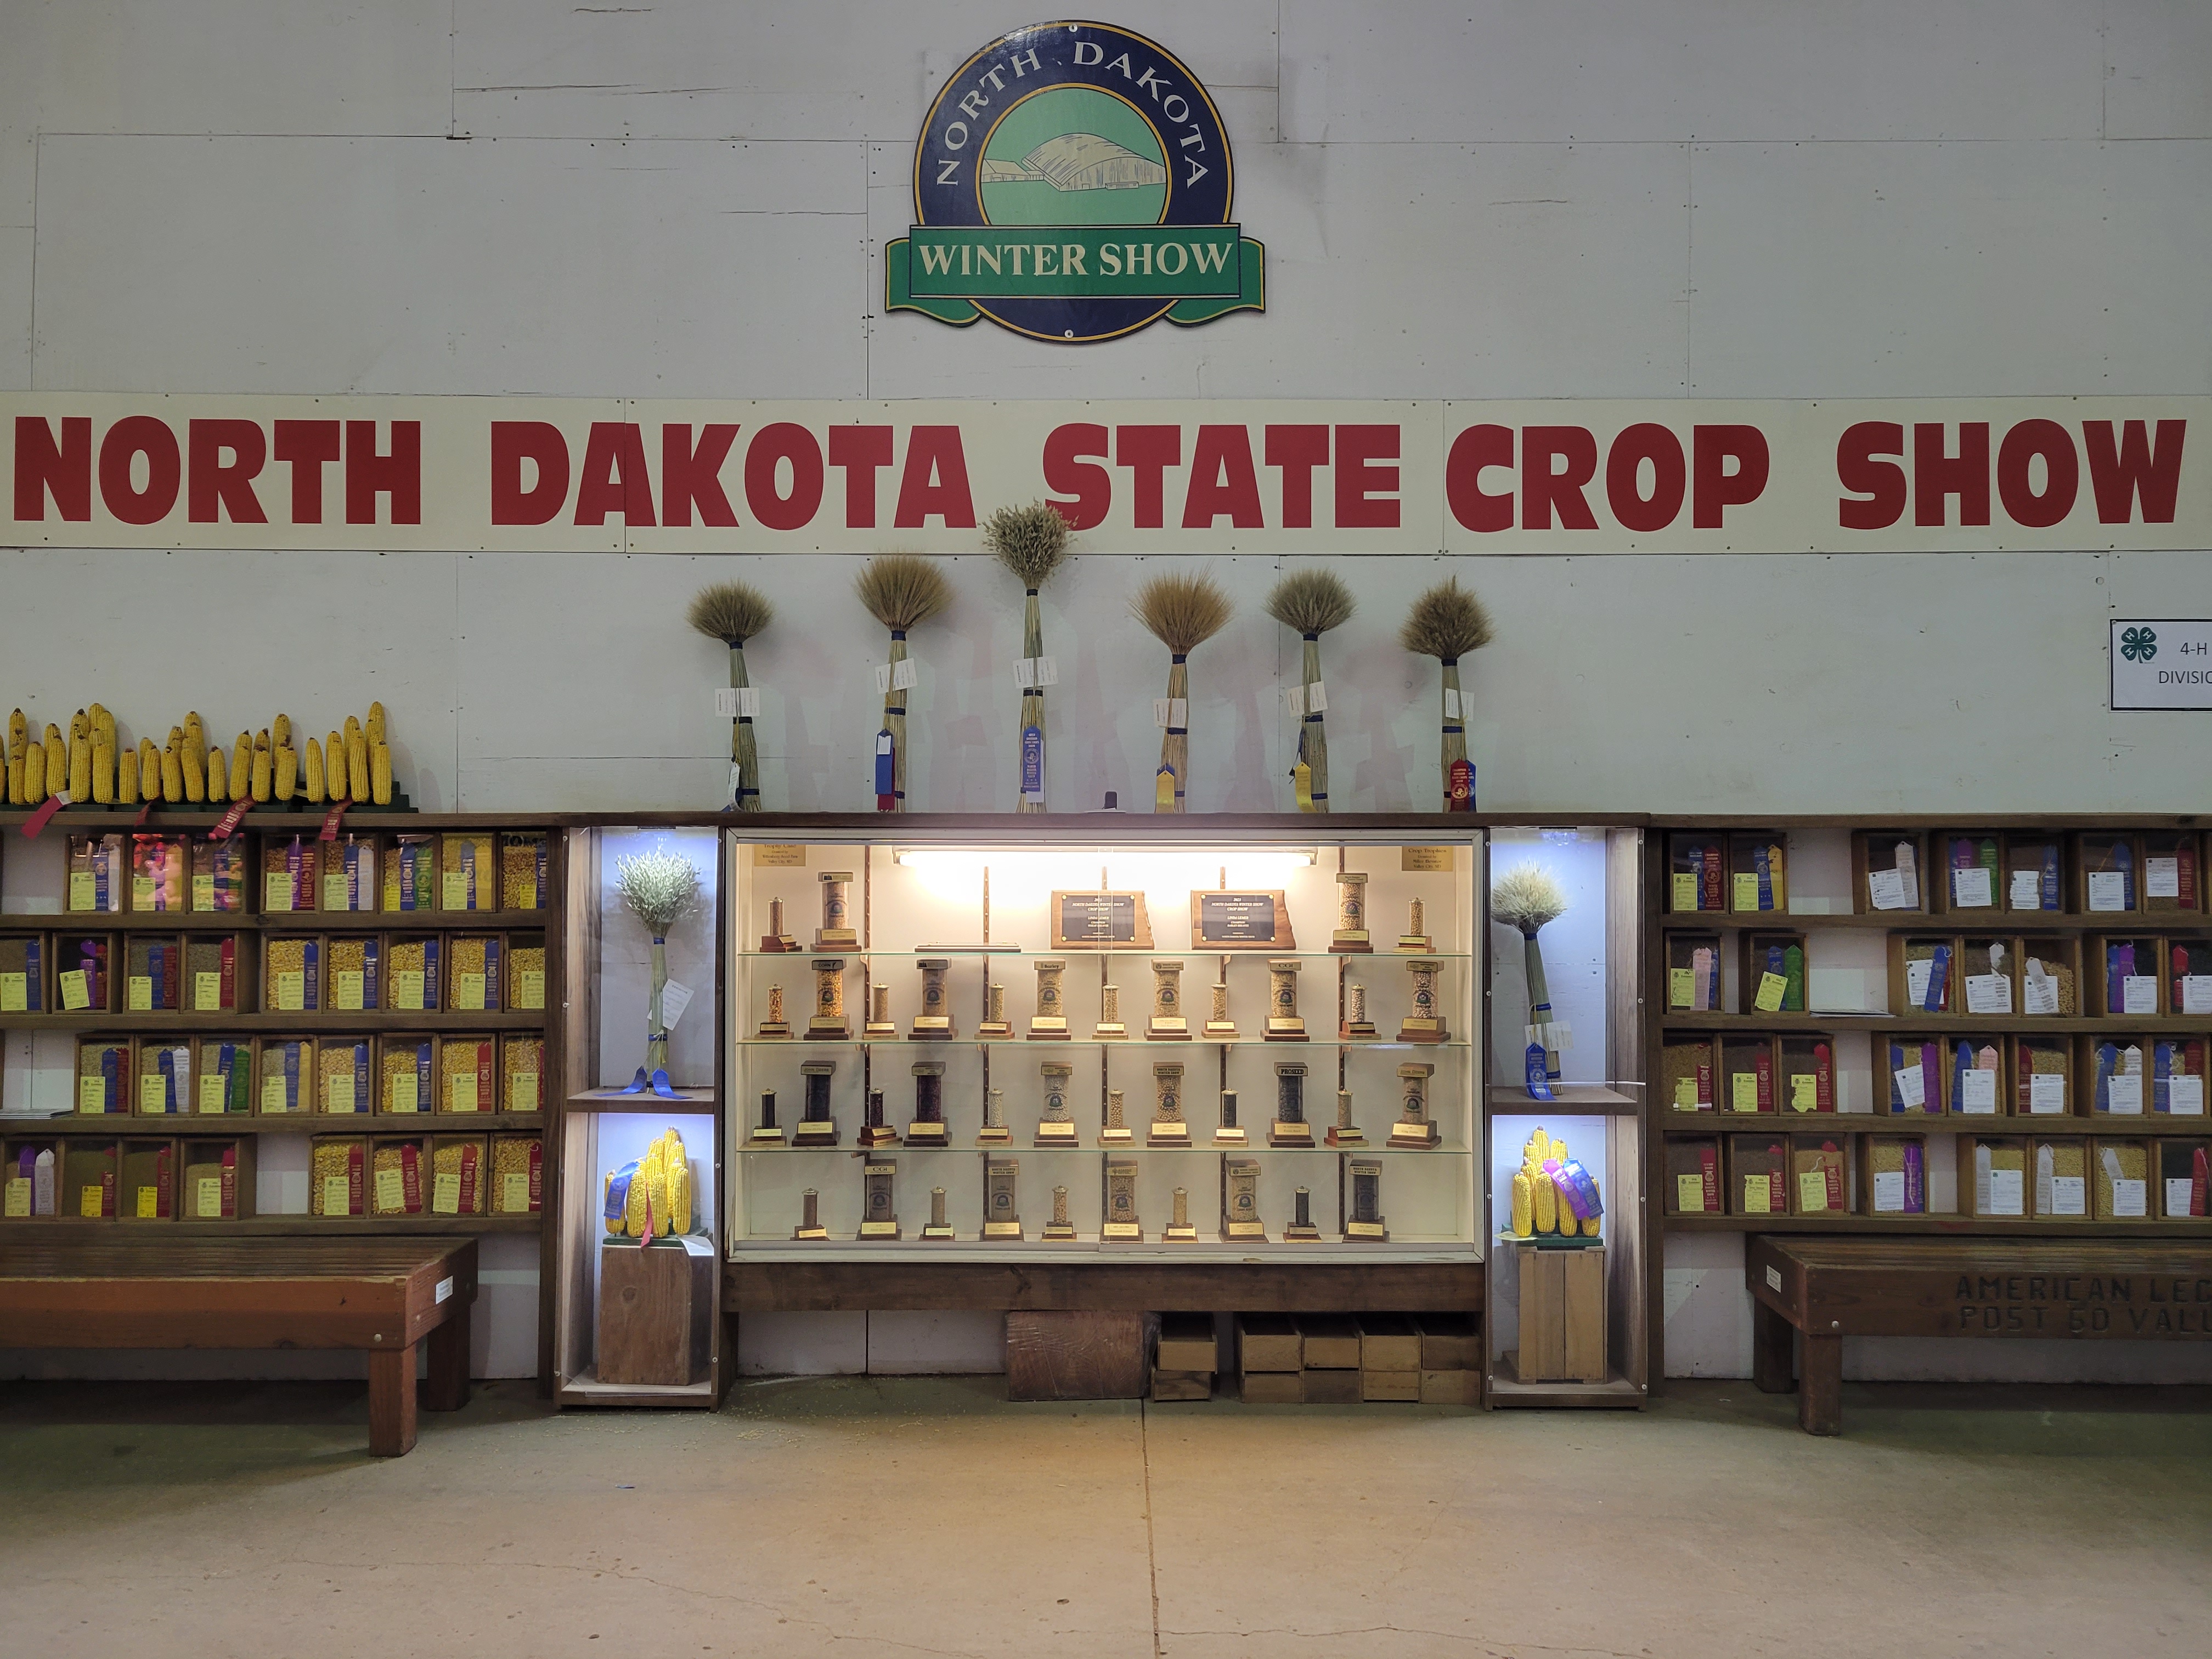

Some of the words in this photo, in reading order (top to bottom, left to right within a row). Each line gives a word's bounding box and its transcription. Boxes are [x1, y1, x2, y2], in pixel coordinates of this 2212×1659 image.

[936, 49, 1041, 187] NORTH
[1073, 41, 1209, 189] DAKOTA
[918, 243, 1090, 276] WINTER
[1099, 242, 1234, 276] SHOW
[14, 415, 421, 524] NORTH
[491, 421, 977, 531] DAKOTA
[1043, 422, 1401, 531] STATE
[1446, 422, 1769, 533] CROP
[1837, 419, 2187, 529] SHOW
[2180, 642, 2208, 656] 4-H
[1956, 1276, 2131, 1302] AMERICAN
[1959, 1306, 2049, 1331] POST
